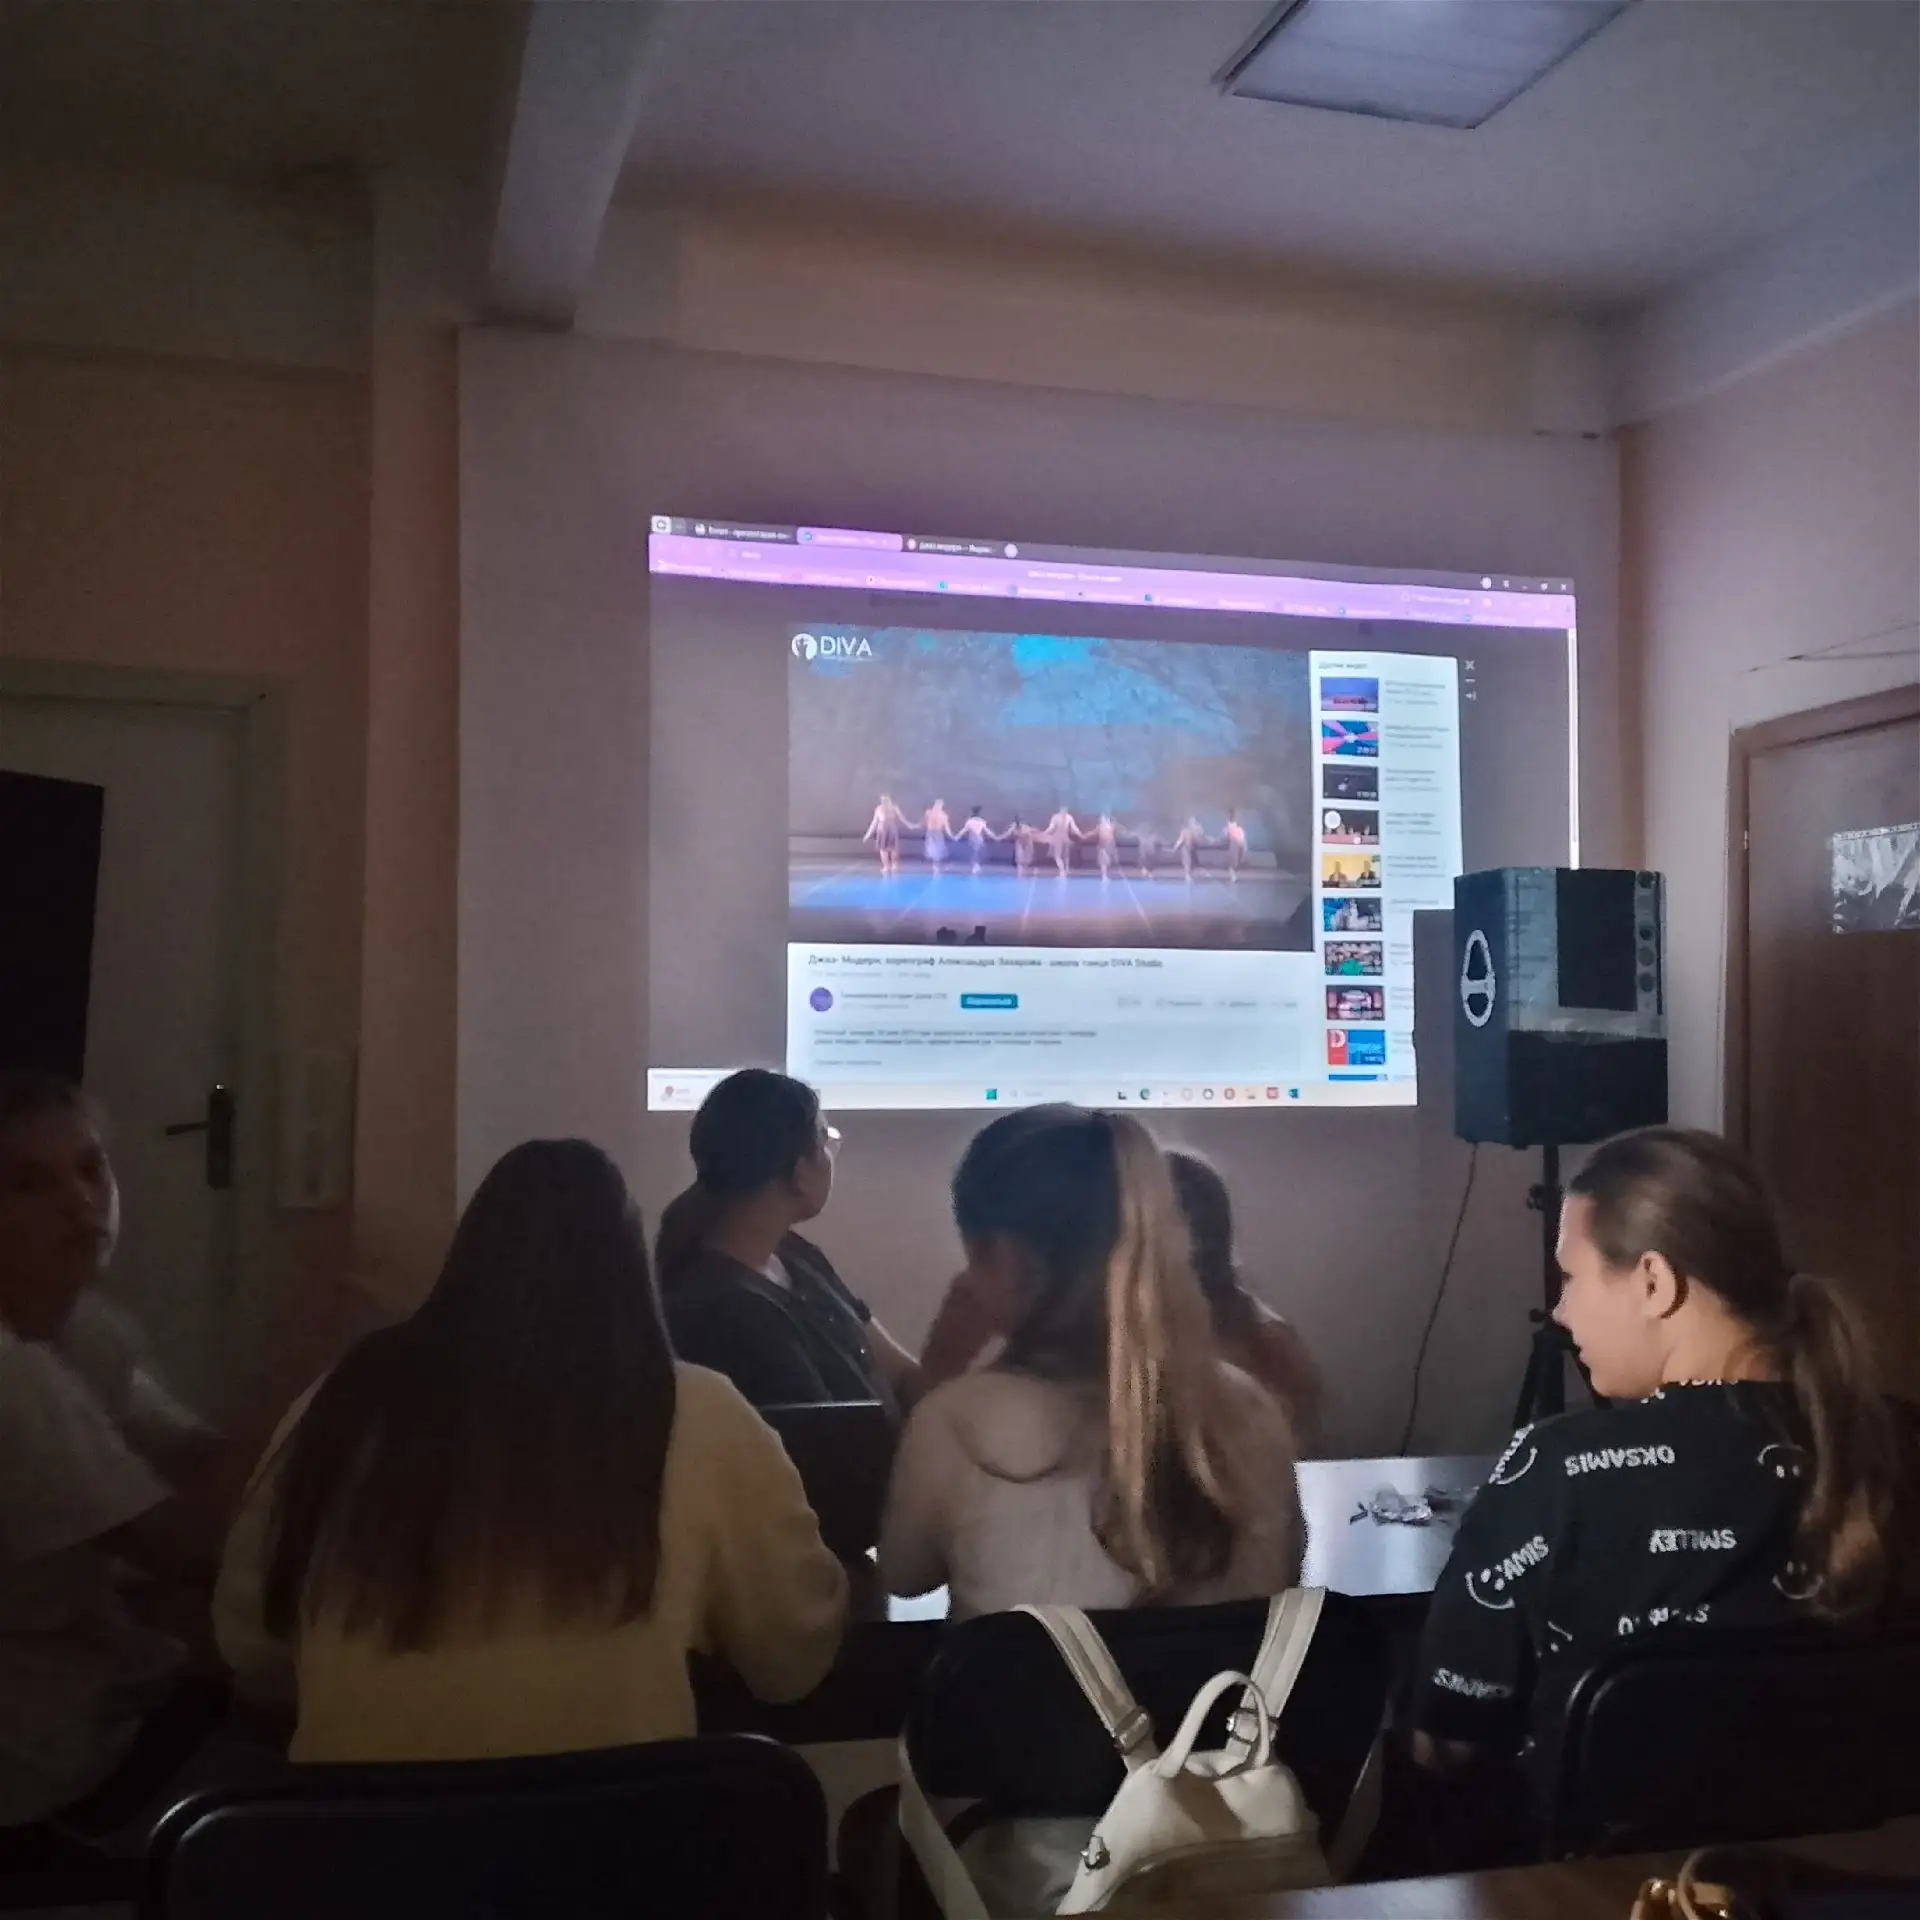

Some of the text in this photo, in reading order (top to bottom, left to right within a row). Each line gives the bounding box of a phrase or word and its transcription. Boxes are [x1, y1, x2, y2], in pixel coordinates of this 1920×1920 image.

[820, 635, 873, 656] DIVA
[1564, 1443, 1677, 1477] OKSAMIS
[1495, 1535, 1549, 1580] AMIS
